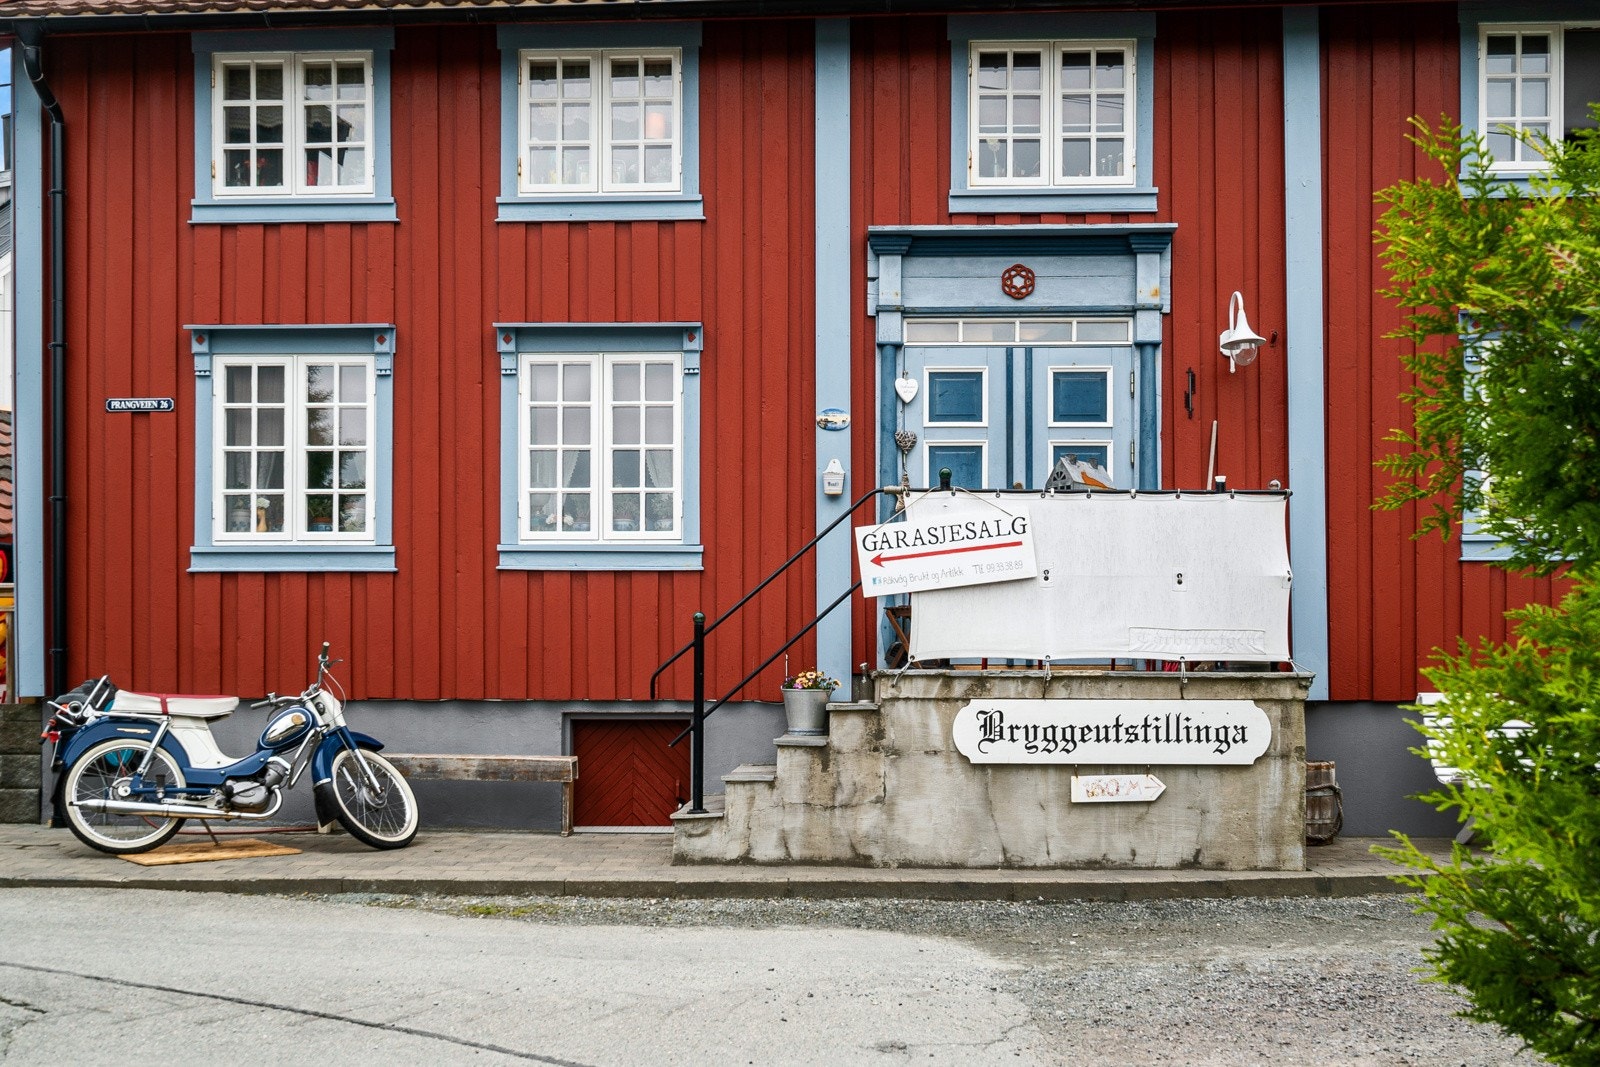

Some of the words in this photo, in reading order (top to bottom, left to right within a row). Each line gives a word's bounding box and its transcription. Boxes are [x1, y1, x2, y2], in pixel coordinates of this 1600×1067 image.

[111, 400, 158, 409] PRANGVEIEN
[160, 400, 169, 409] 26
[862, 517, 1028, 551] GARASJESALG
[909, 571, 929, 583] Brukt
[931, 572, 940, 583] og
[976, 708, 1249, 755] Bryggeutstillinga
